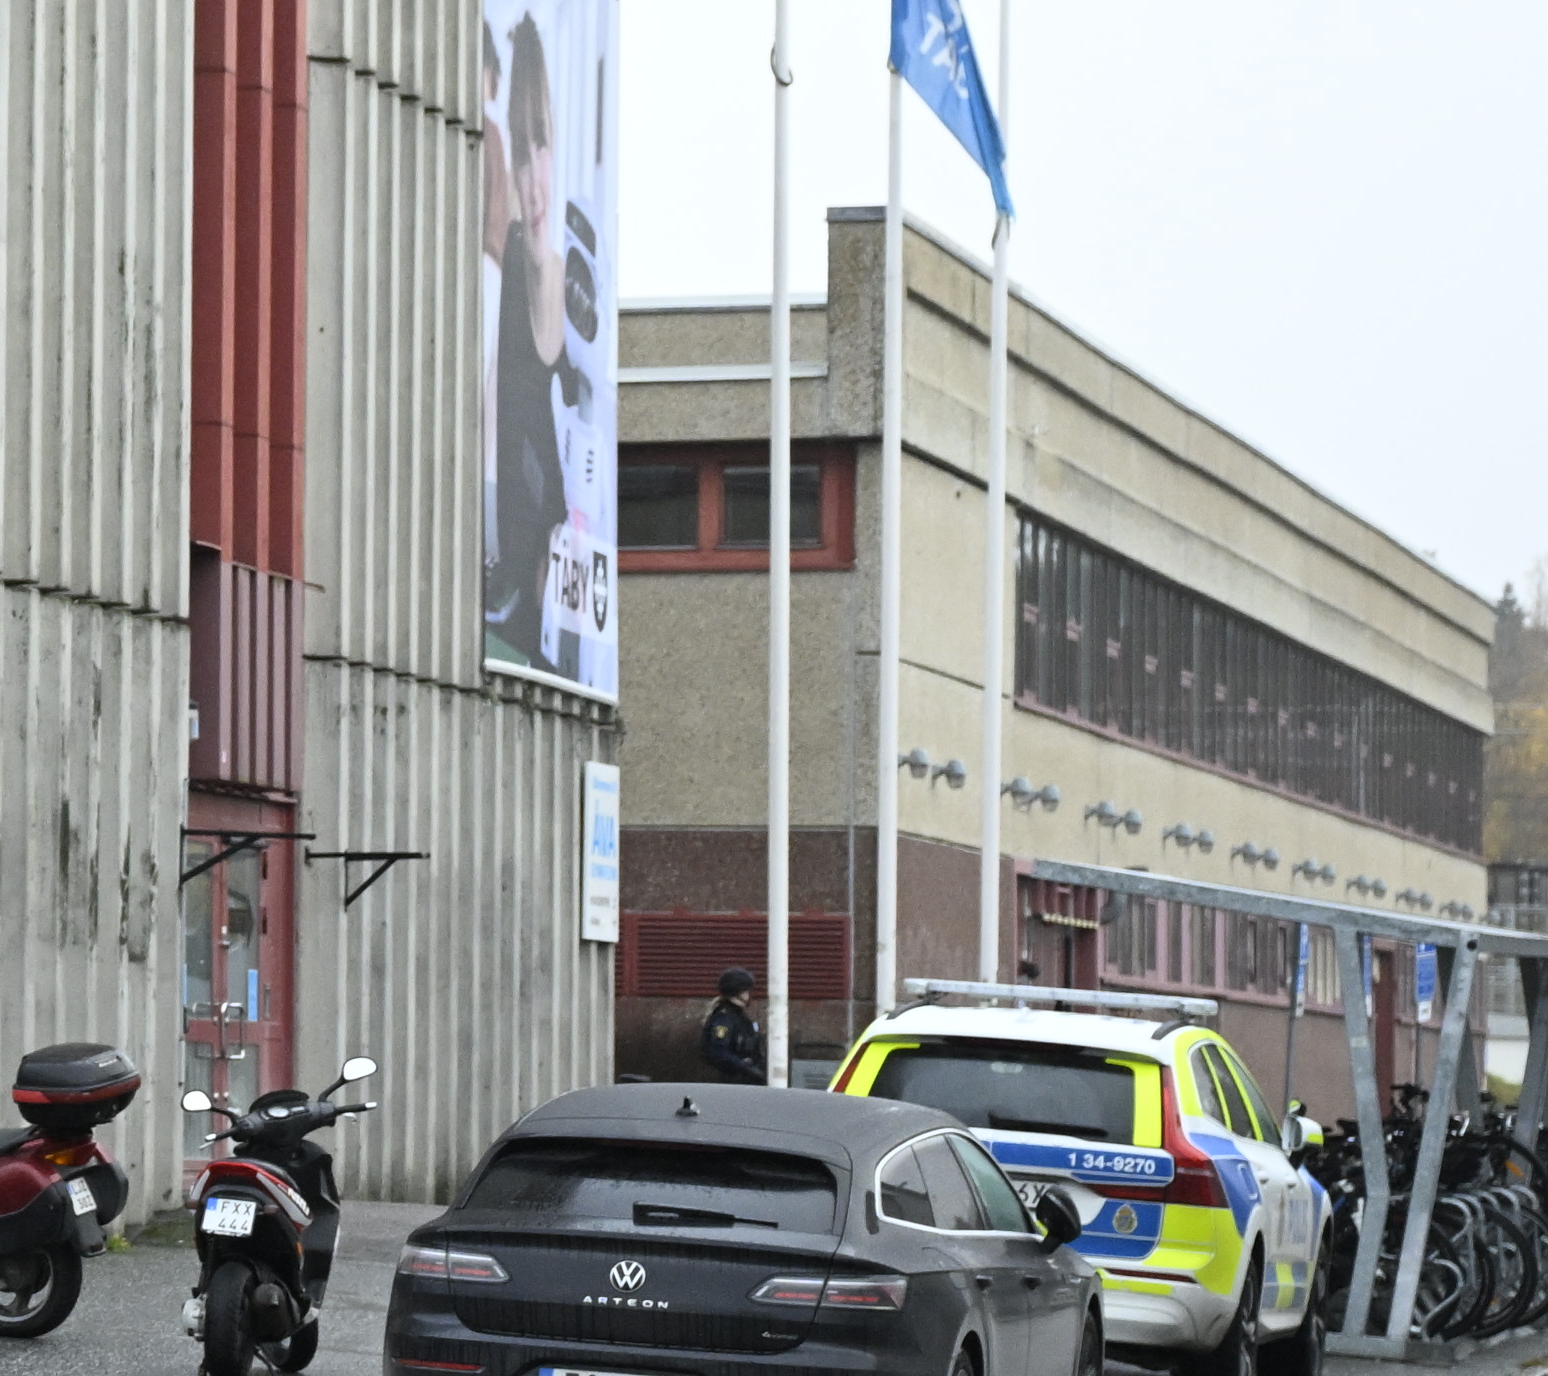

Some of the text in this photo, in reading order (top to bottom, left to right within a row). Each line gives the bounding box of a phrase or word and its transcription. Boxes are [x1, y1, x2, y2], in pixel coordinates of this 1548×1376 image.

[552, 535, 590, 614] TÄBY
[1068, 1153, 1156, 1175] 1 34-9270
[221, 1201, 253, 1216] FXX
[218, 1218, 249, 1231] 444
[582, 1295, 669, 1310] ARTEON
